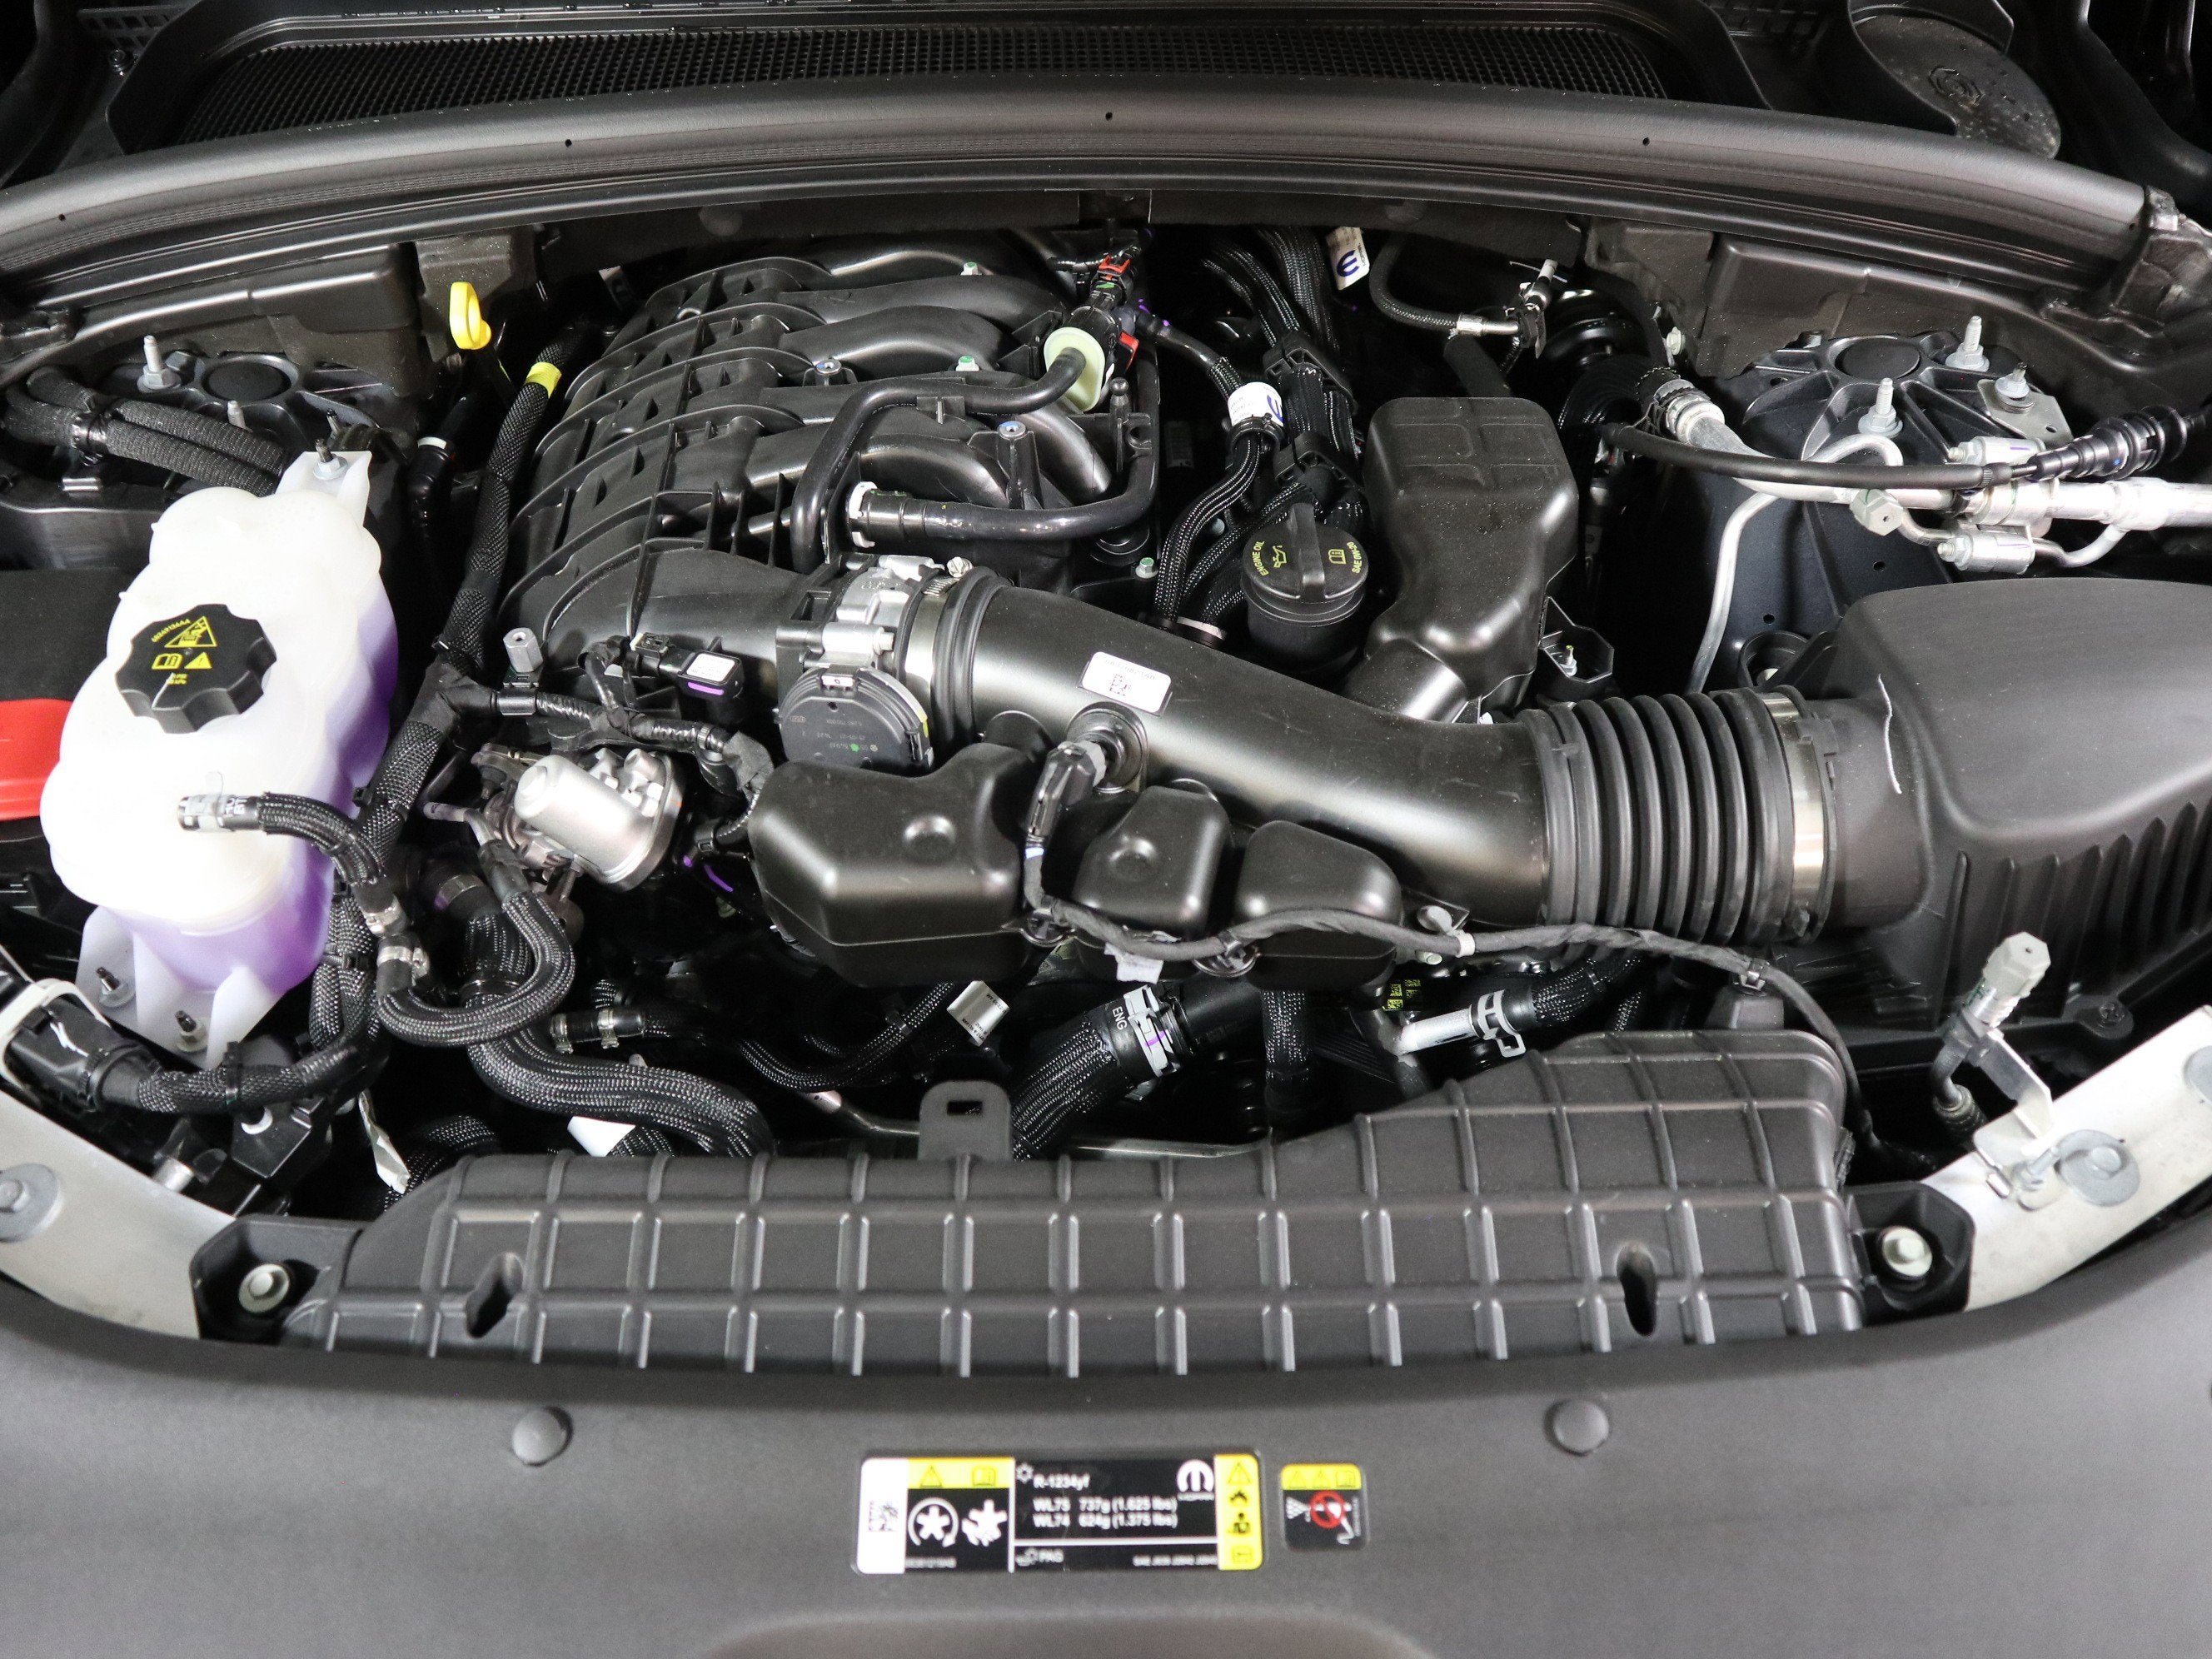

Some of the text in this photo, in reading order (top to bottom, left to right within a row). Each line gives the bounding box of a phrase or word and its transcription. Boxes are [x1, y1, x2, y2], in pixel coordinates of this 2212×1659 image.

[1252, 541, 1269, 576] ENGINE OIL
[1351, 560, 1363, 574] SAE
[1112, 1006, 1128, 1031] ENG
[1033, 1473, 1090, 1490] R-1234yf
[1079, 1497, 1111, 1513] 737g
[1152, 1496, 1178, 1512] lbs)
[1152, 1512, 1178, 1529] lbs)
